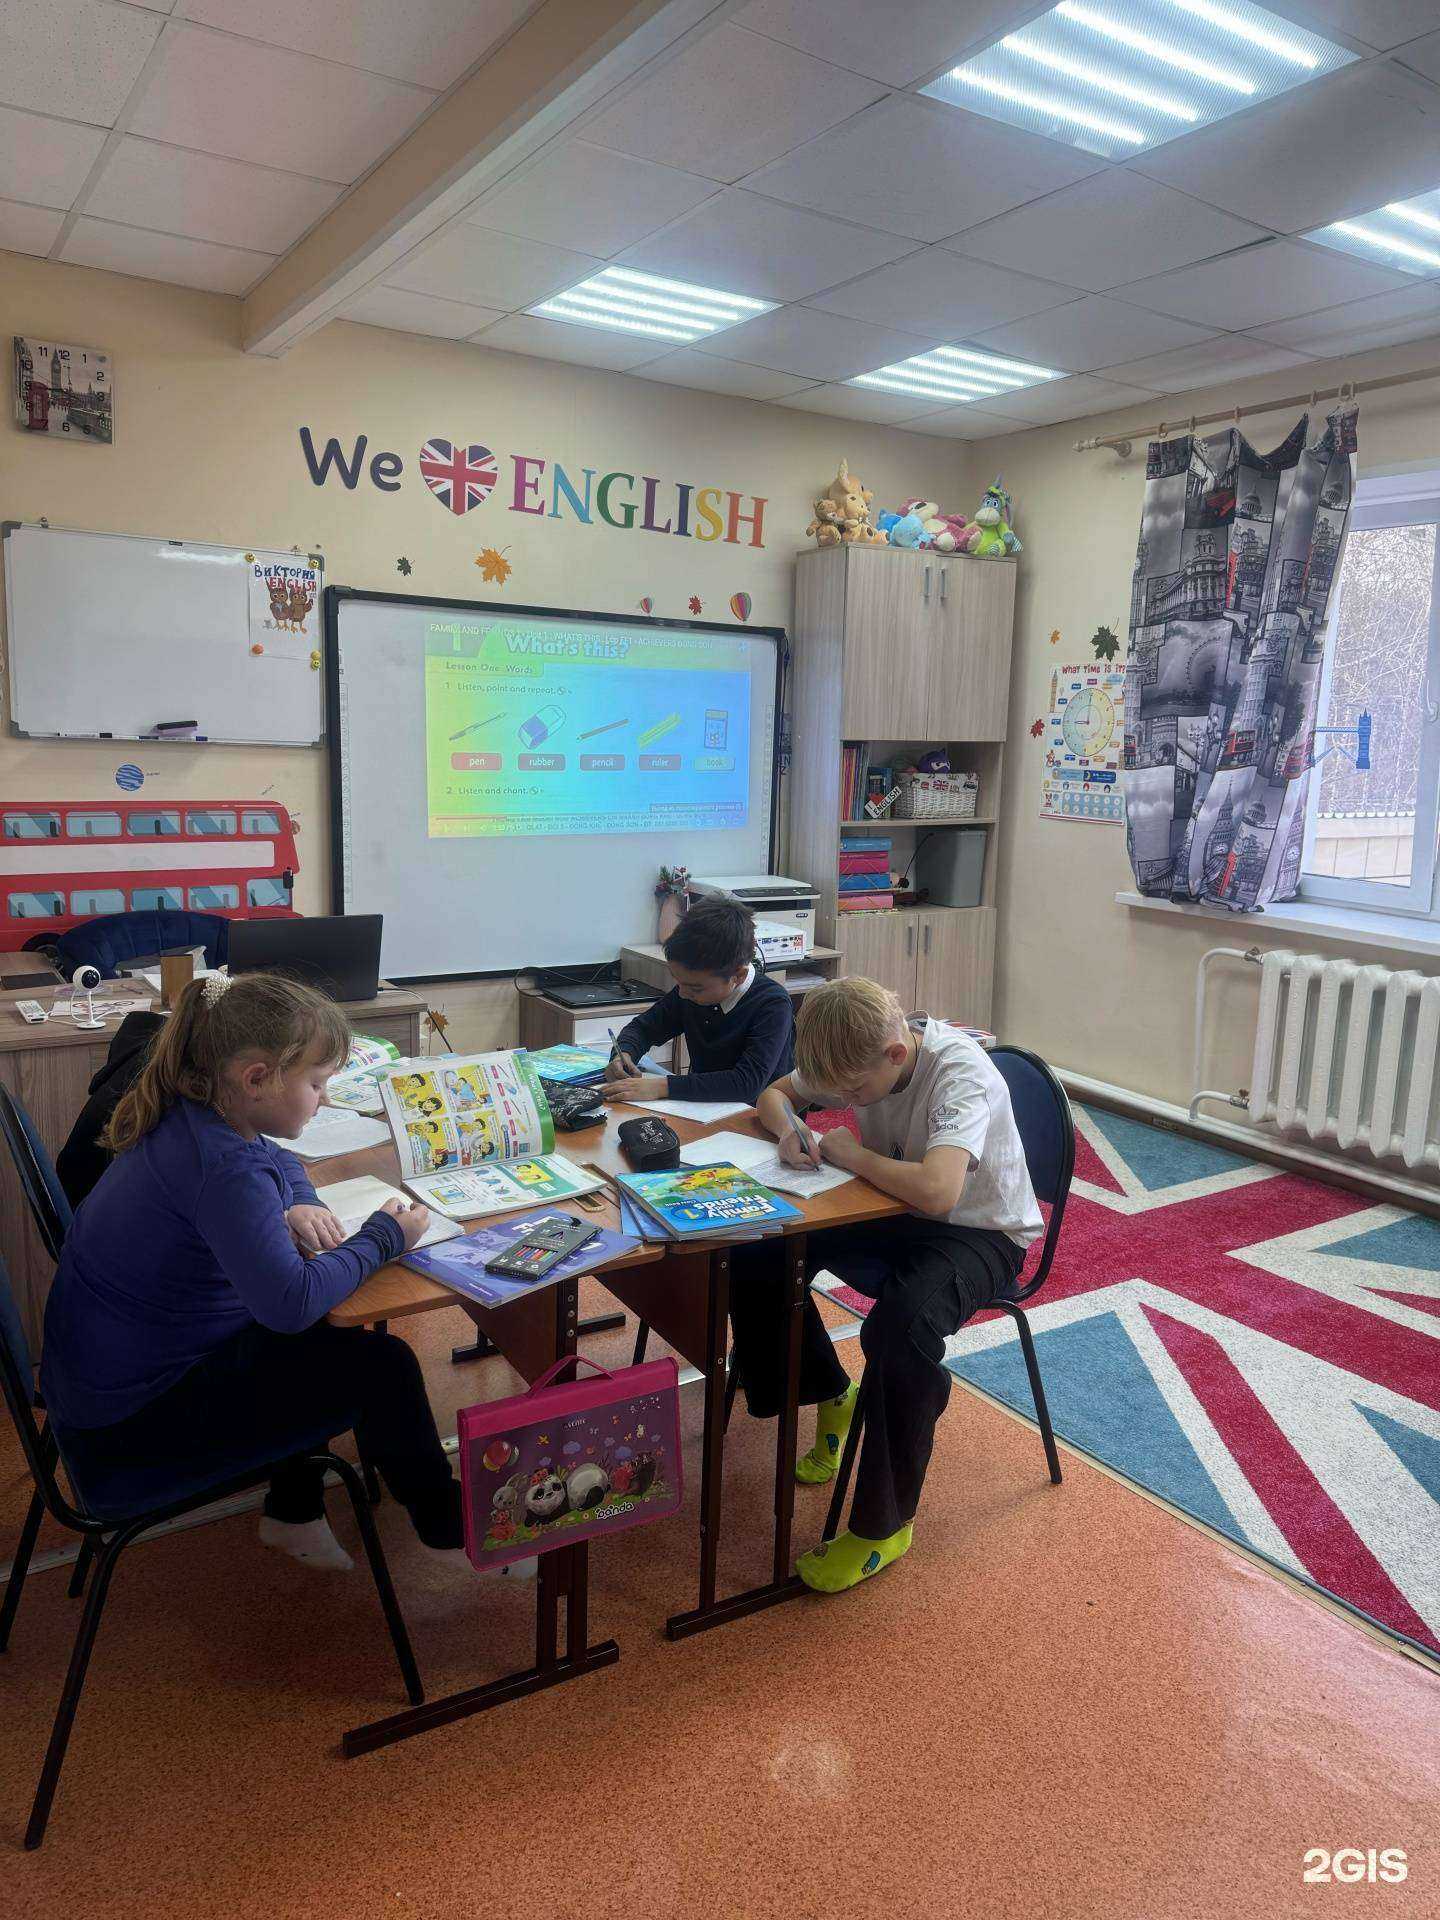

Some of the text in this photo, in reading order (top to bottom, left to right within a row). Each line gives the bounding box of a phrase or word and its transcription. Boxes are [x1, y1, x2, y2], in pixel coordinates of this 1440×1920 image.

[38, 346, 48, 357] 11
[58, 349, 70, 360] 12
[82, 354, 87, 363] 1
[22, 359, 33, 370] 10
[96, 371, 104, 382] 2
[97, 391, 105, 402] 3
[62, 422, 70, 432] 6
[300, 426, 769, 548] We ENGLISH
[504, 631, 579, 656] What's
[583, 636, 631, 659] this?
[446, 661, 533, 674] Lesson One Words
[457, 683, 486, 692] Listen,
[486, 685, 508, 695] point
[510, 686, 526, 694] and
[528, 687, 556, 696] repeat.
[469, 758, 485, 767] pen
[529, 757, 555, 767] rubber
[591, 757, 615, 767] pencil
[446, 786, 529, 795] 2 Listen and chant.
[873, 788, 900, 815] ENGLISH
[693, 1194, 769, 1210] Friends
[707, 1202, 777, 1219] Family
[594, 1502, 635, 1519] panda
